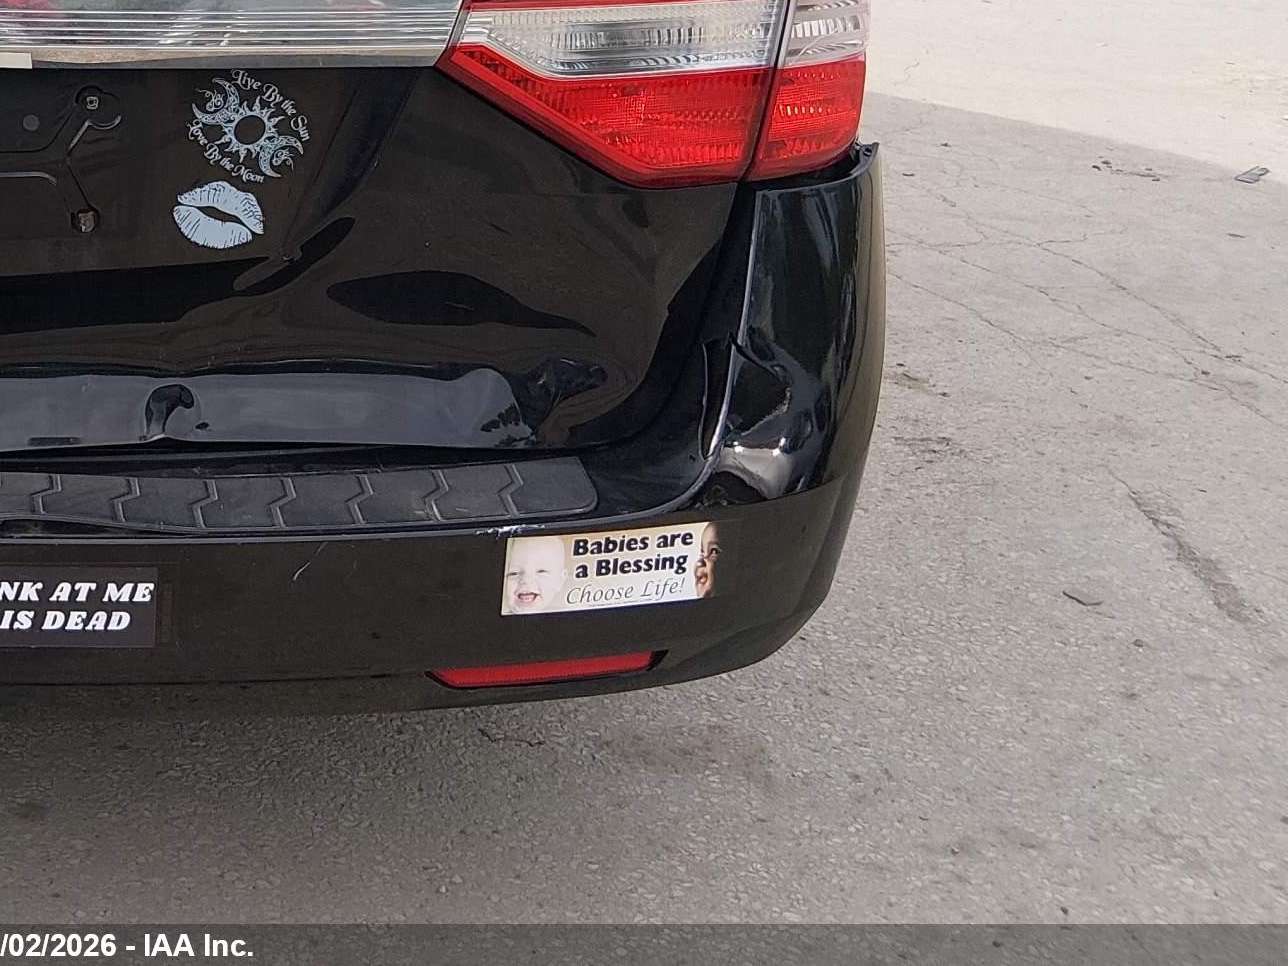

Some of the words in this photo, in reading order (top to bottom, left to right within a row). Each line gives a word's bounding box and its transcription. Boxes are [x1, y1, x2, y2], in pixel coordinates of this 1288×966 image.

[231, 69, 262, 91] Live
[262, 83, 284, 108] By
[280, 99, 297, 116] the
[290, 115, 310, 142] Sun
[186, 118, 209, 146] Love
[203, 142, 222, 166] By
[219, 157, 235, 171] the
[231, 164, 265, 183] Moon
[572, 534, 650, 556] Babies
[656, 531, 694, 548] are
[574, 563, 588, 579] a
[595, 553, 689, 577] Blessing
[49, 582, 97, 602] AT
[102, 582, 156, 602] ME
[566, 583, 634, 605] Choose
[640, 577, 686, 600] Life!
[40, 611, 131, 631] DEAD
